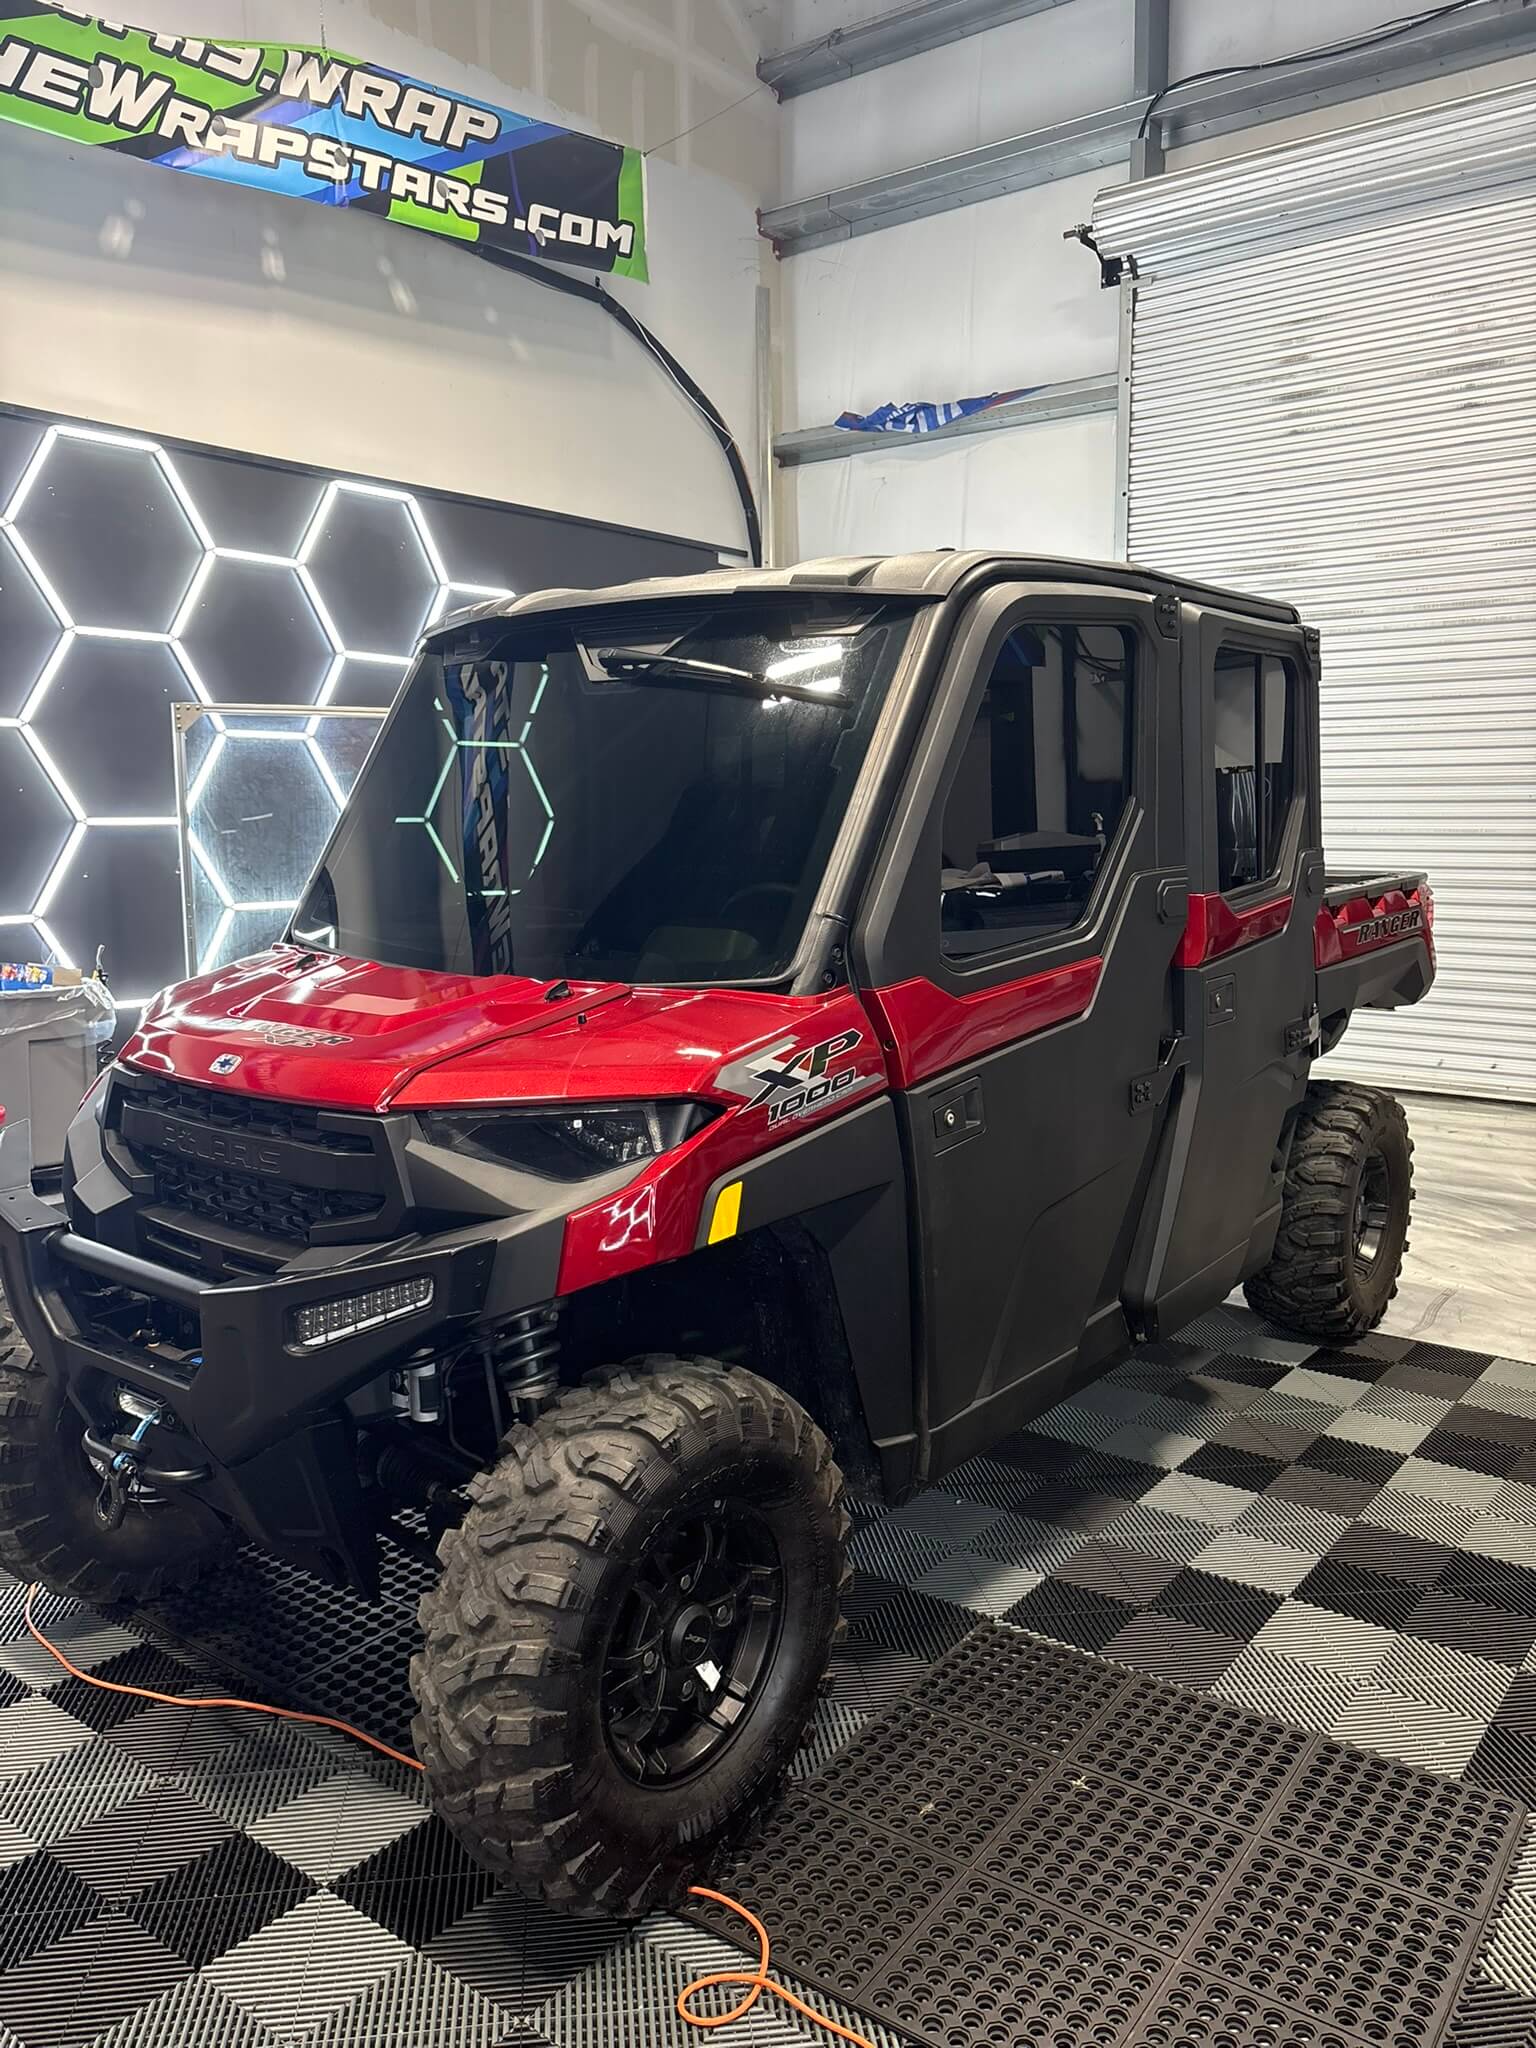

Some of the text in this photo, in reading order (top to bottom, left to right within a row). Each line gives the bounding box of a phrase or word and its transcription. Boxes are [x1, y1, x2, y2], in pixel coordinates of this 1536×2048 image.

[1357, 909, 1420, 944] RANGER
[210, 1018, 354, 1046] RNGER
[736, 1028, 863, 1116] XP
[768, 1066, 857, 1126] 1000
[162, 1125, 281, 1174] POLARIS
